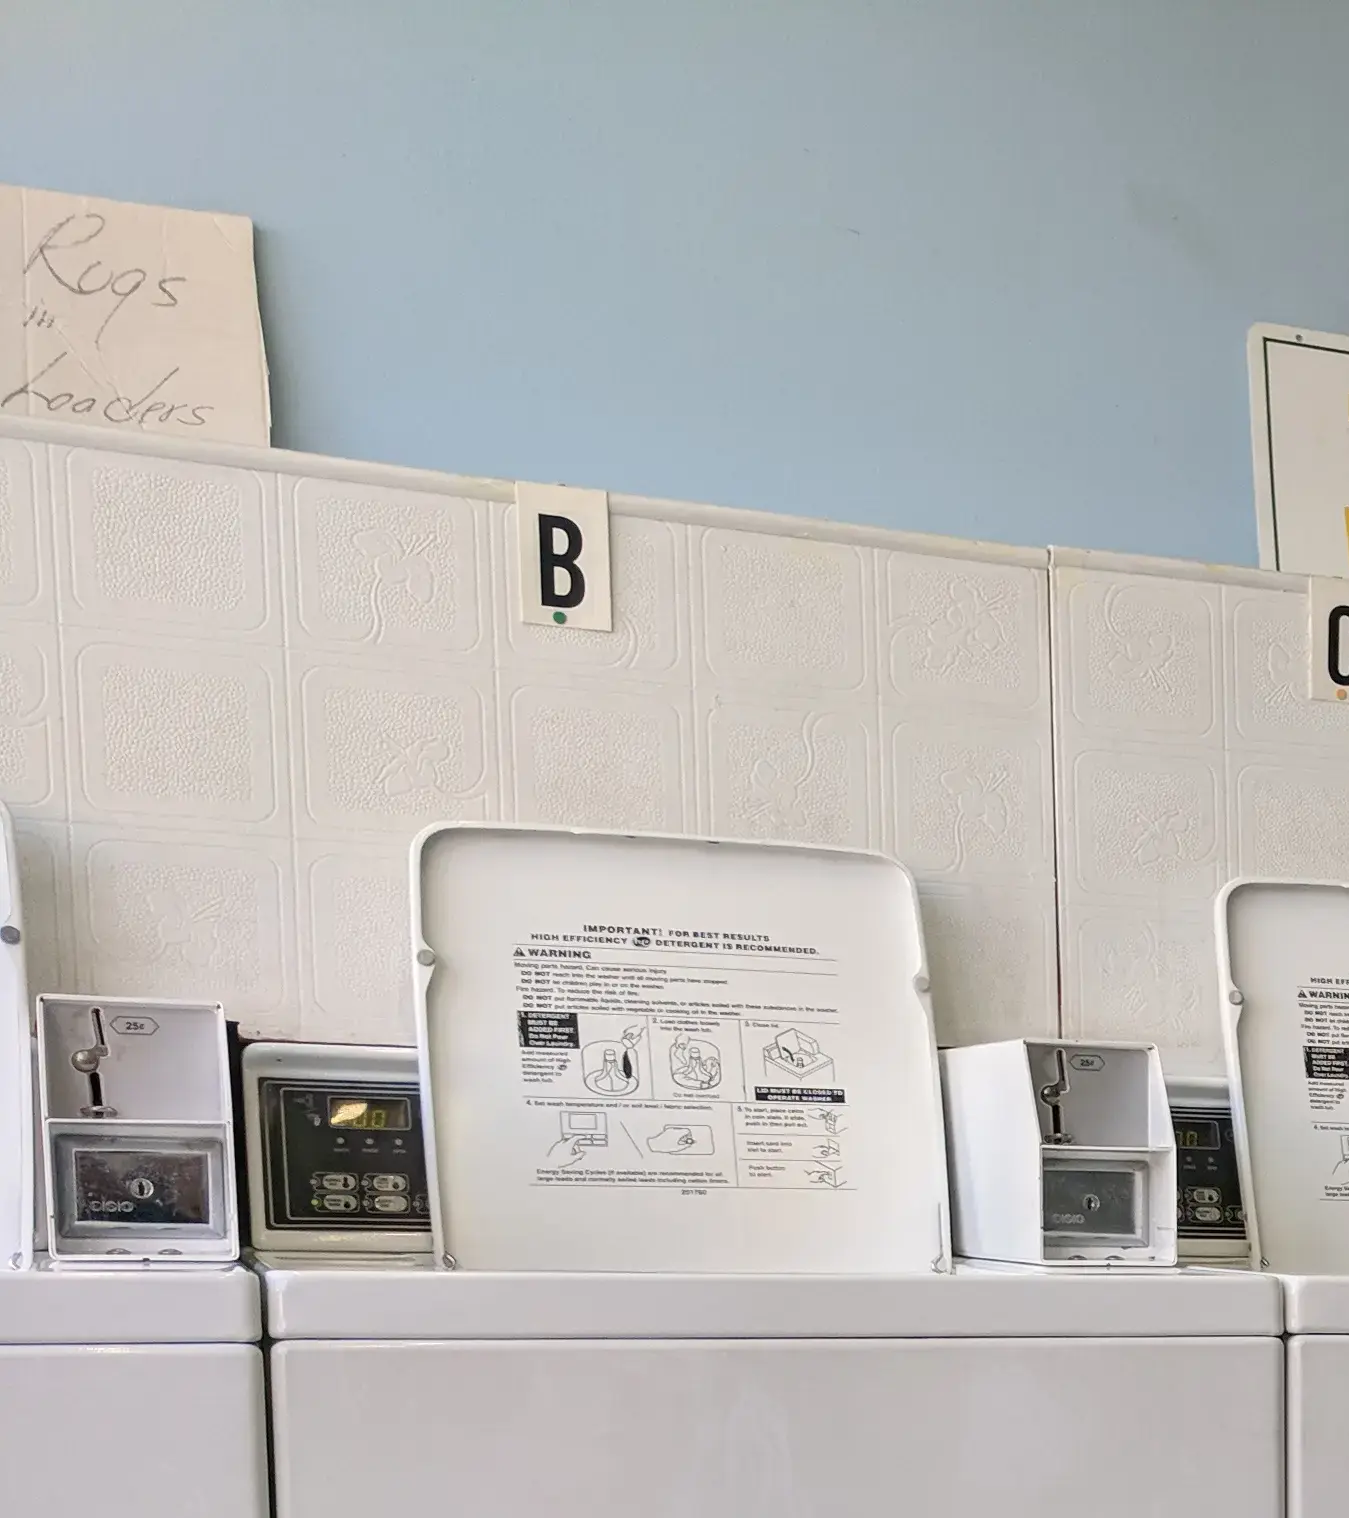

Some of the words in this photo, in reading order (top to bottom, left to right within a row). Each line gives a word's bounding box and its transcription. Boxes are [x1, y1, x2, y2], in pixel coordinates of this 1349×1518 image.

[23, 213, 187, 352] Rugs
[0, 351, 215, 429] Loaders
[538, 513, 586, 609] B
[530, 933, 560, 942] HIGH
[562, 934, 628, 945] EFFICIENCY
[655, 939, 719, 950] DETERGENT
[735, 943, 820, 955] RECOMMENDED.
[583, 924, 663, 936] IMPORTANT!
[668, 930, 690, 938] FOR
[693, 931, 719, 940] BEST
[722, 933, 770, 942] RESULTS
[527, 949, 592, 959] WARNING
[1310, 977, 1333, 985] HIGH
